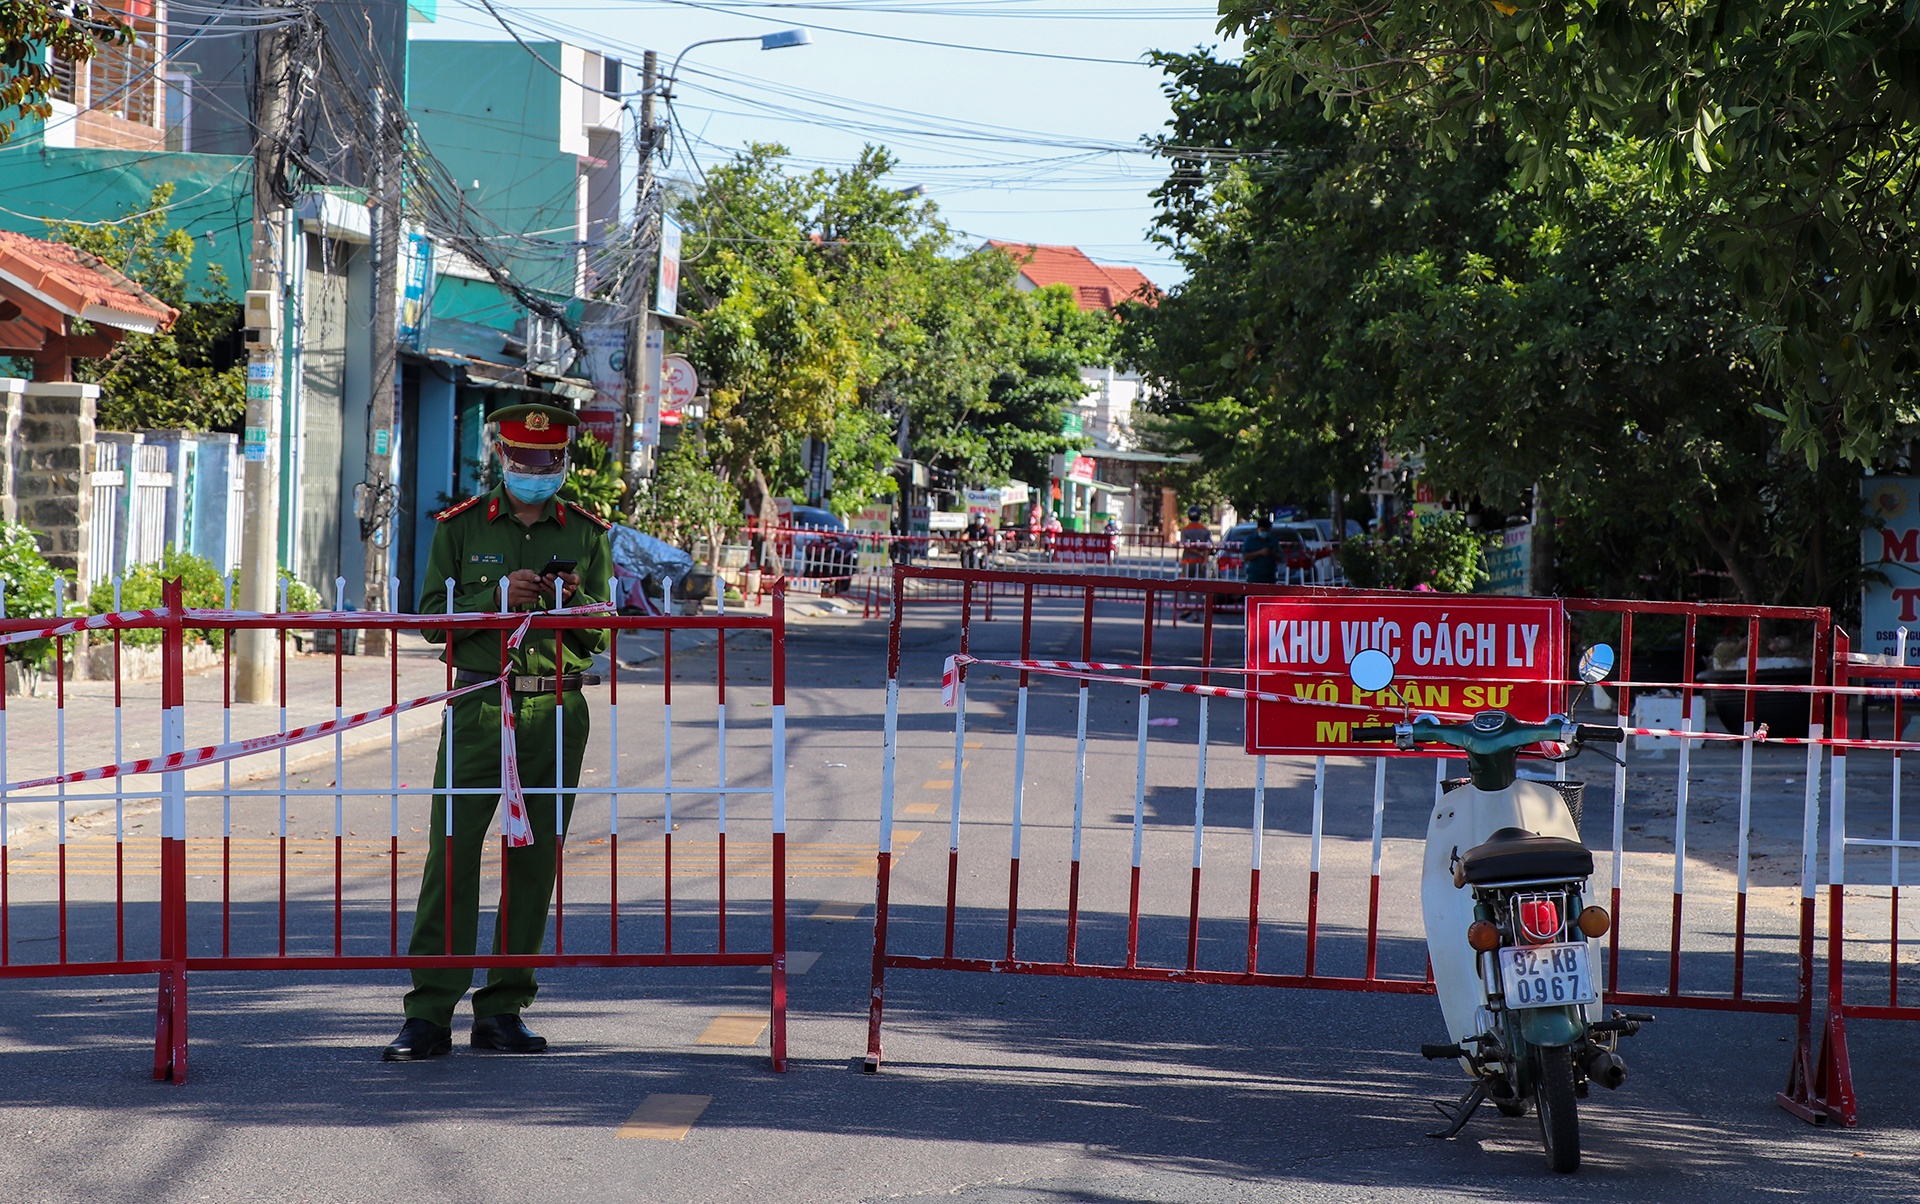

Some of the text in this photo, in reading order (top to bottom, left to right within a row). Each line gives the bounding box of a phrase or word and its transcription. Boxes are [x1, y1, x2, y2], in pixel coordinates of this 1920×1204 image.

[1268, 619, 1330, 664] KHU
[1412, 613, 1496, 667] CÁCH
[1507, 624, 1540, 667] LY
[1513, 948, 1577, 976] 92-KB
[1517, 975, 1579, 1003] 0967
